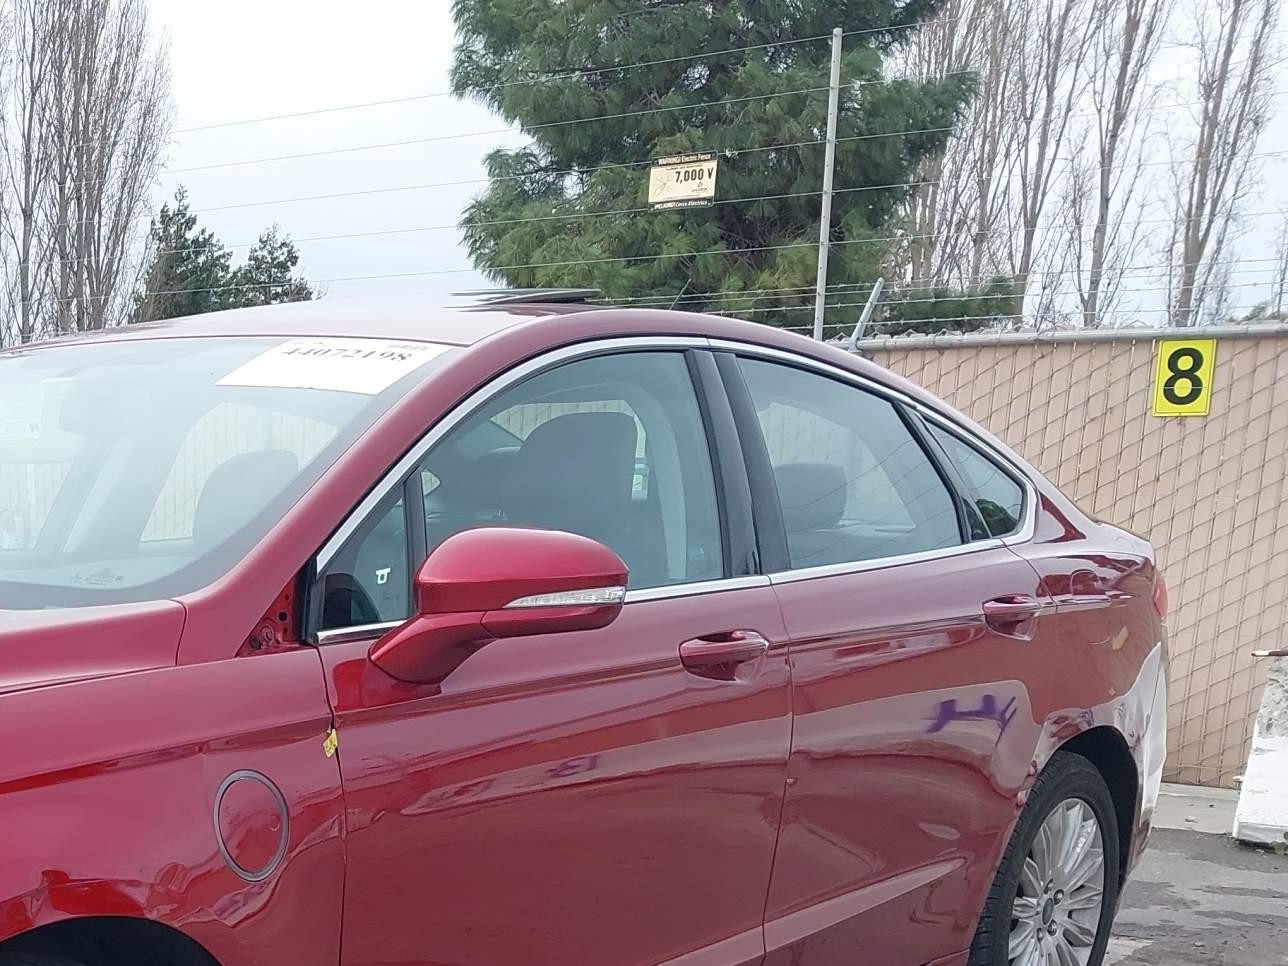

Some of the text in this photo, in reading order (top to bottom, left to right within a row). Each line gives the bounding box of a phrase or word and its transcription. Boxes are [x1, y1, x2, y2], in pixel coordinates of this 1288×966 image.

[675, 168, 704, 184] 7,000
[707, 167, 714, 179] V
[1163, 347, 1204, 405] 8
